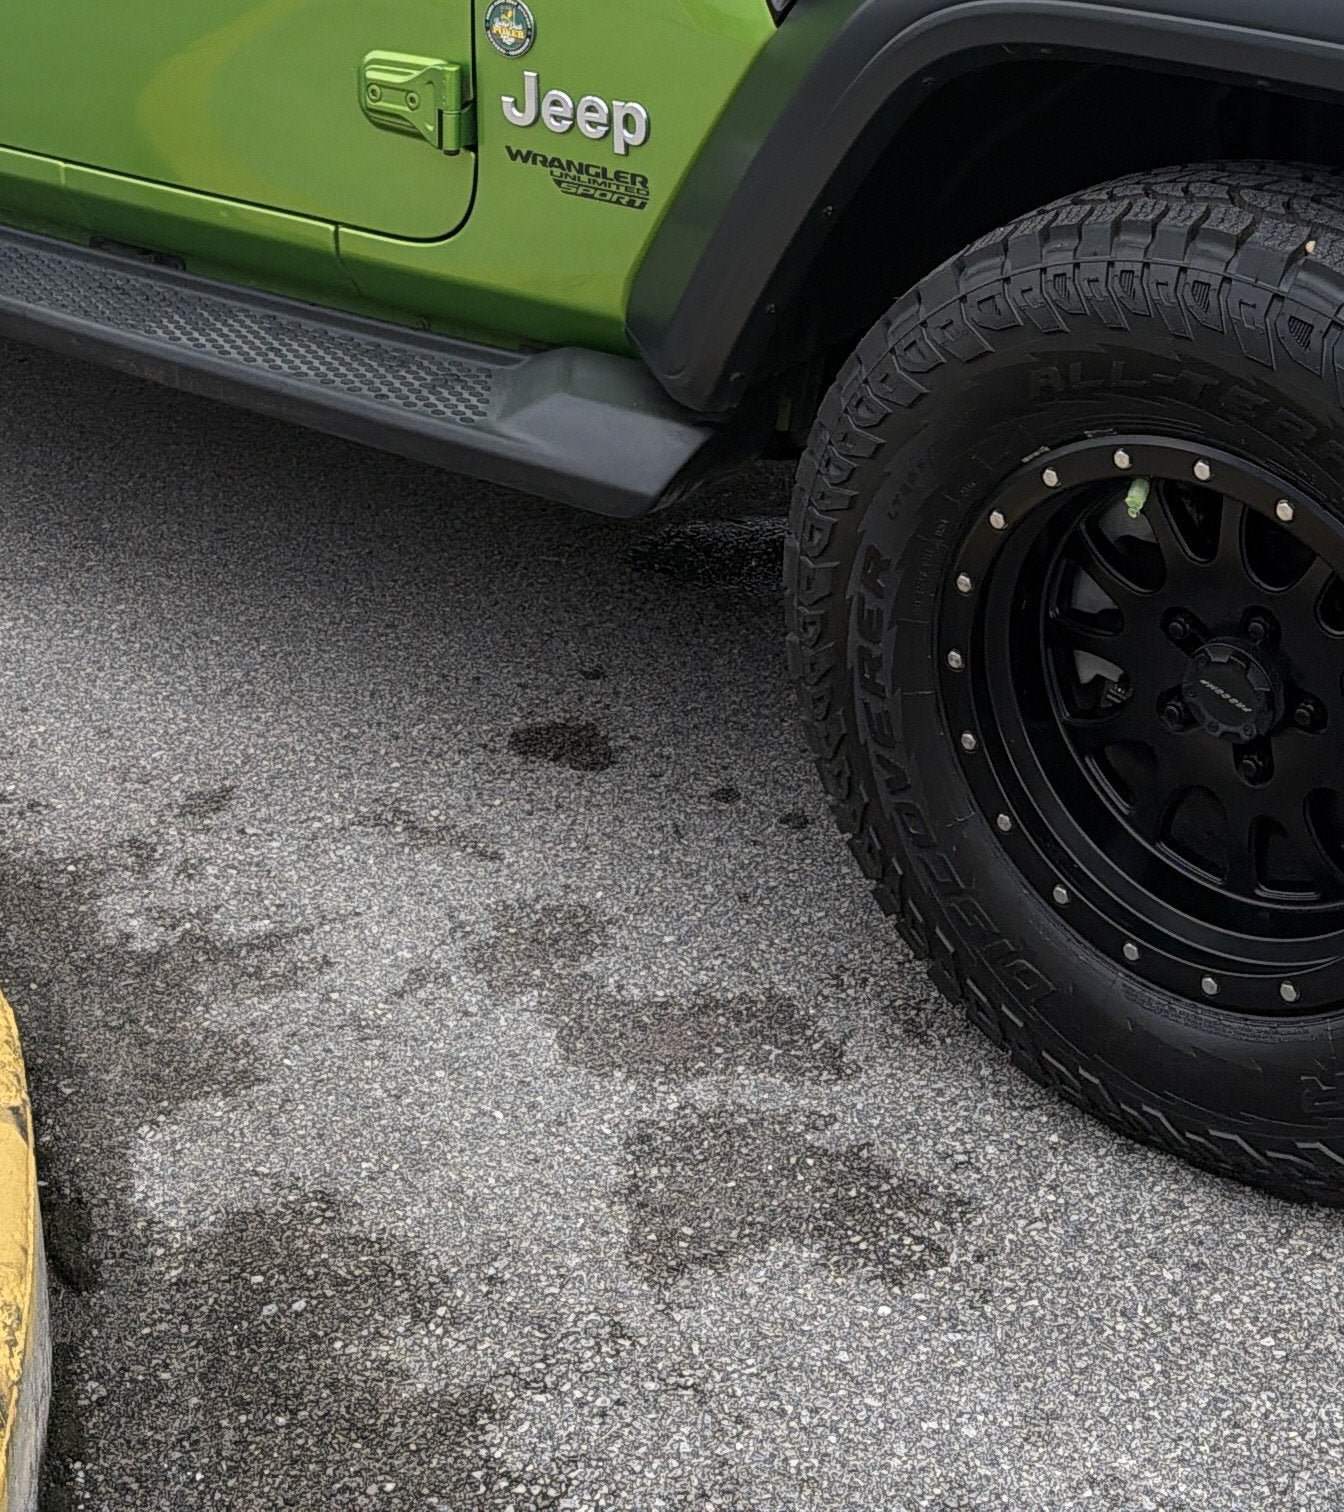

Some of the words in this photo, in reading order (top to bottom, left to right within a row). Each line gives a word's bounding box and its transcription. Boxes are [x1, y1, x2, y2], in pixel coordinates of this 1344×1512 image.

[501, 70, 650, 157] Jeep
[505, 145, 649, 188] WRANGLER
[549, 169, 650, 197] UNLIMITED
[558, 180, 648, 209] SPORT
